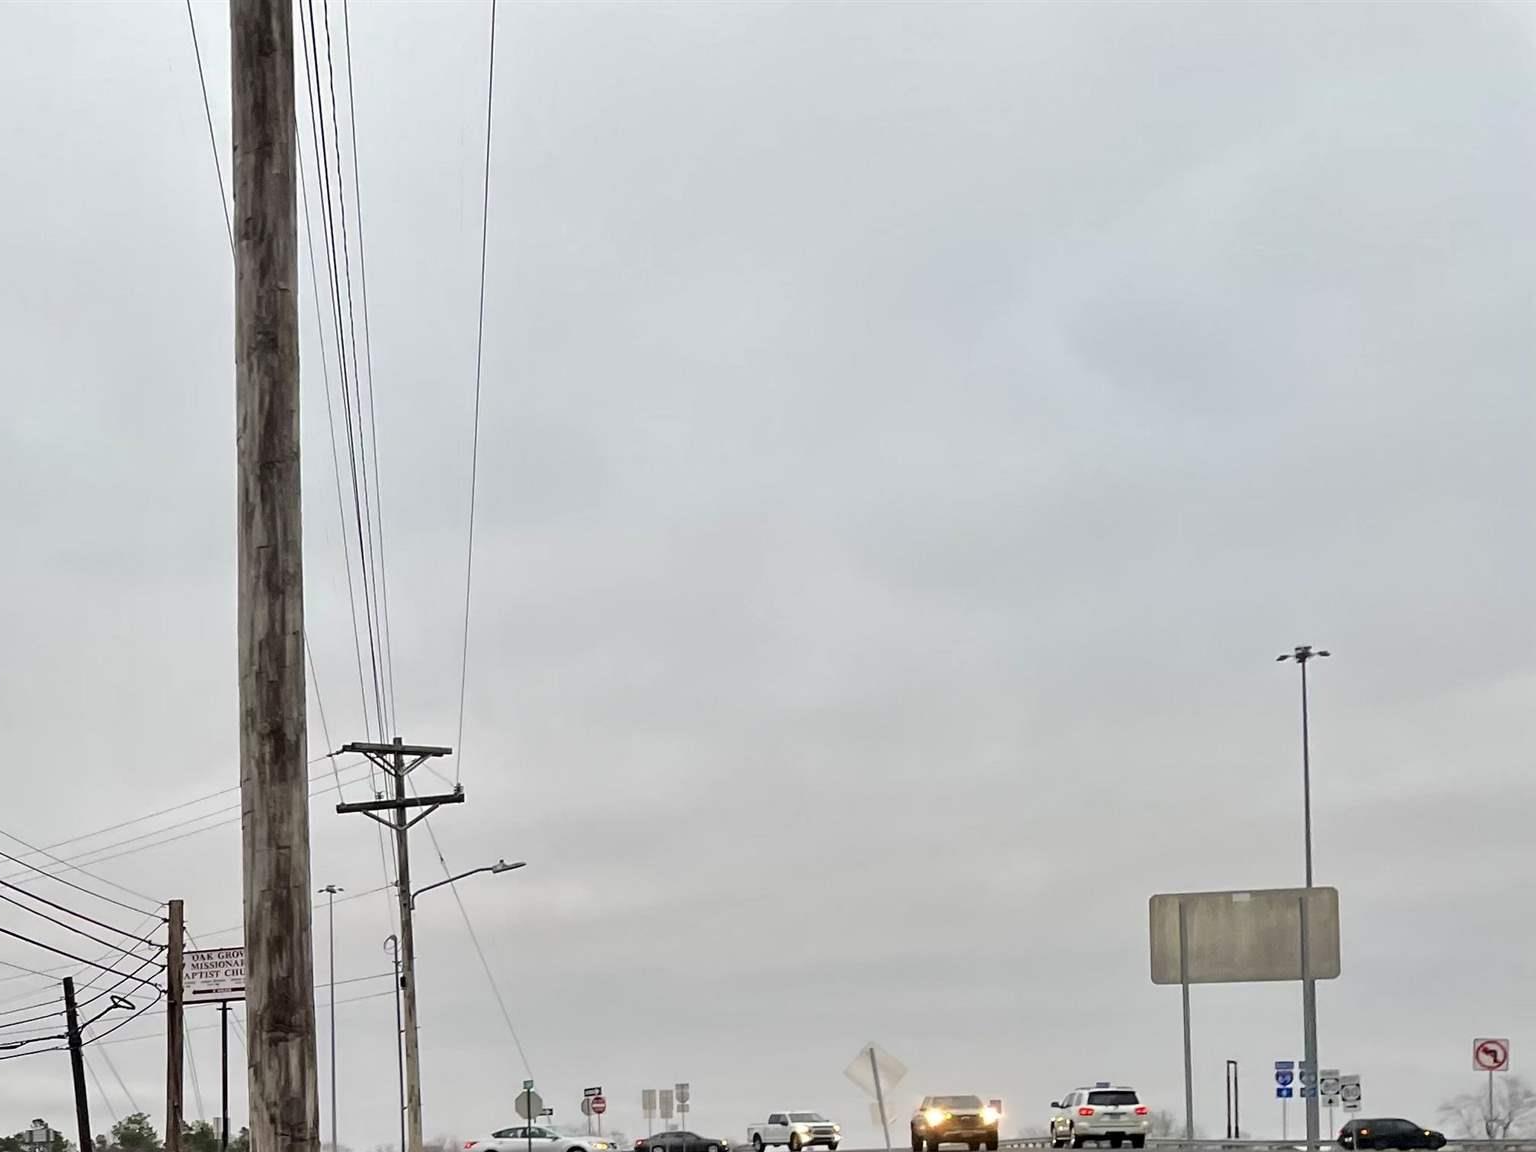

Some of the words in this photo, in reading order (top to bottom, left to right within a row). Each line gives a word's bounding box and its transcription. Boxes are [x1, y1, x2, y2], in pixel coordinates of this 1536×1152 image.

[192, 953, 214, 961] OAK
[183, 970, 220, 980] APTIST
[224, 968, 245, 977] CHU
